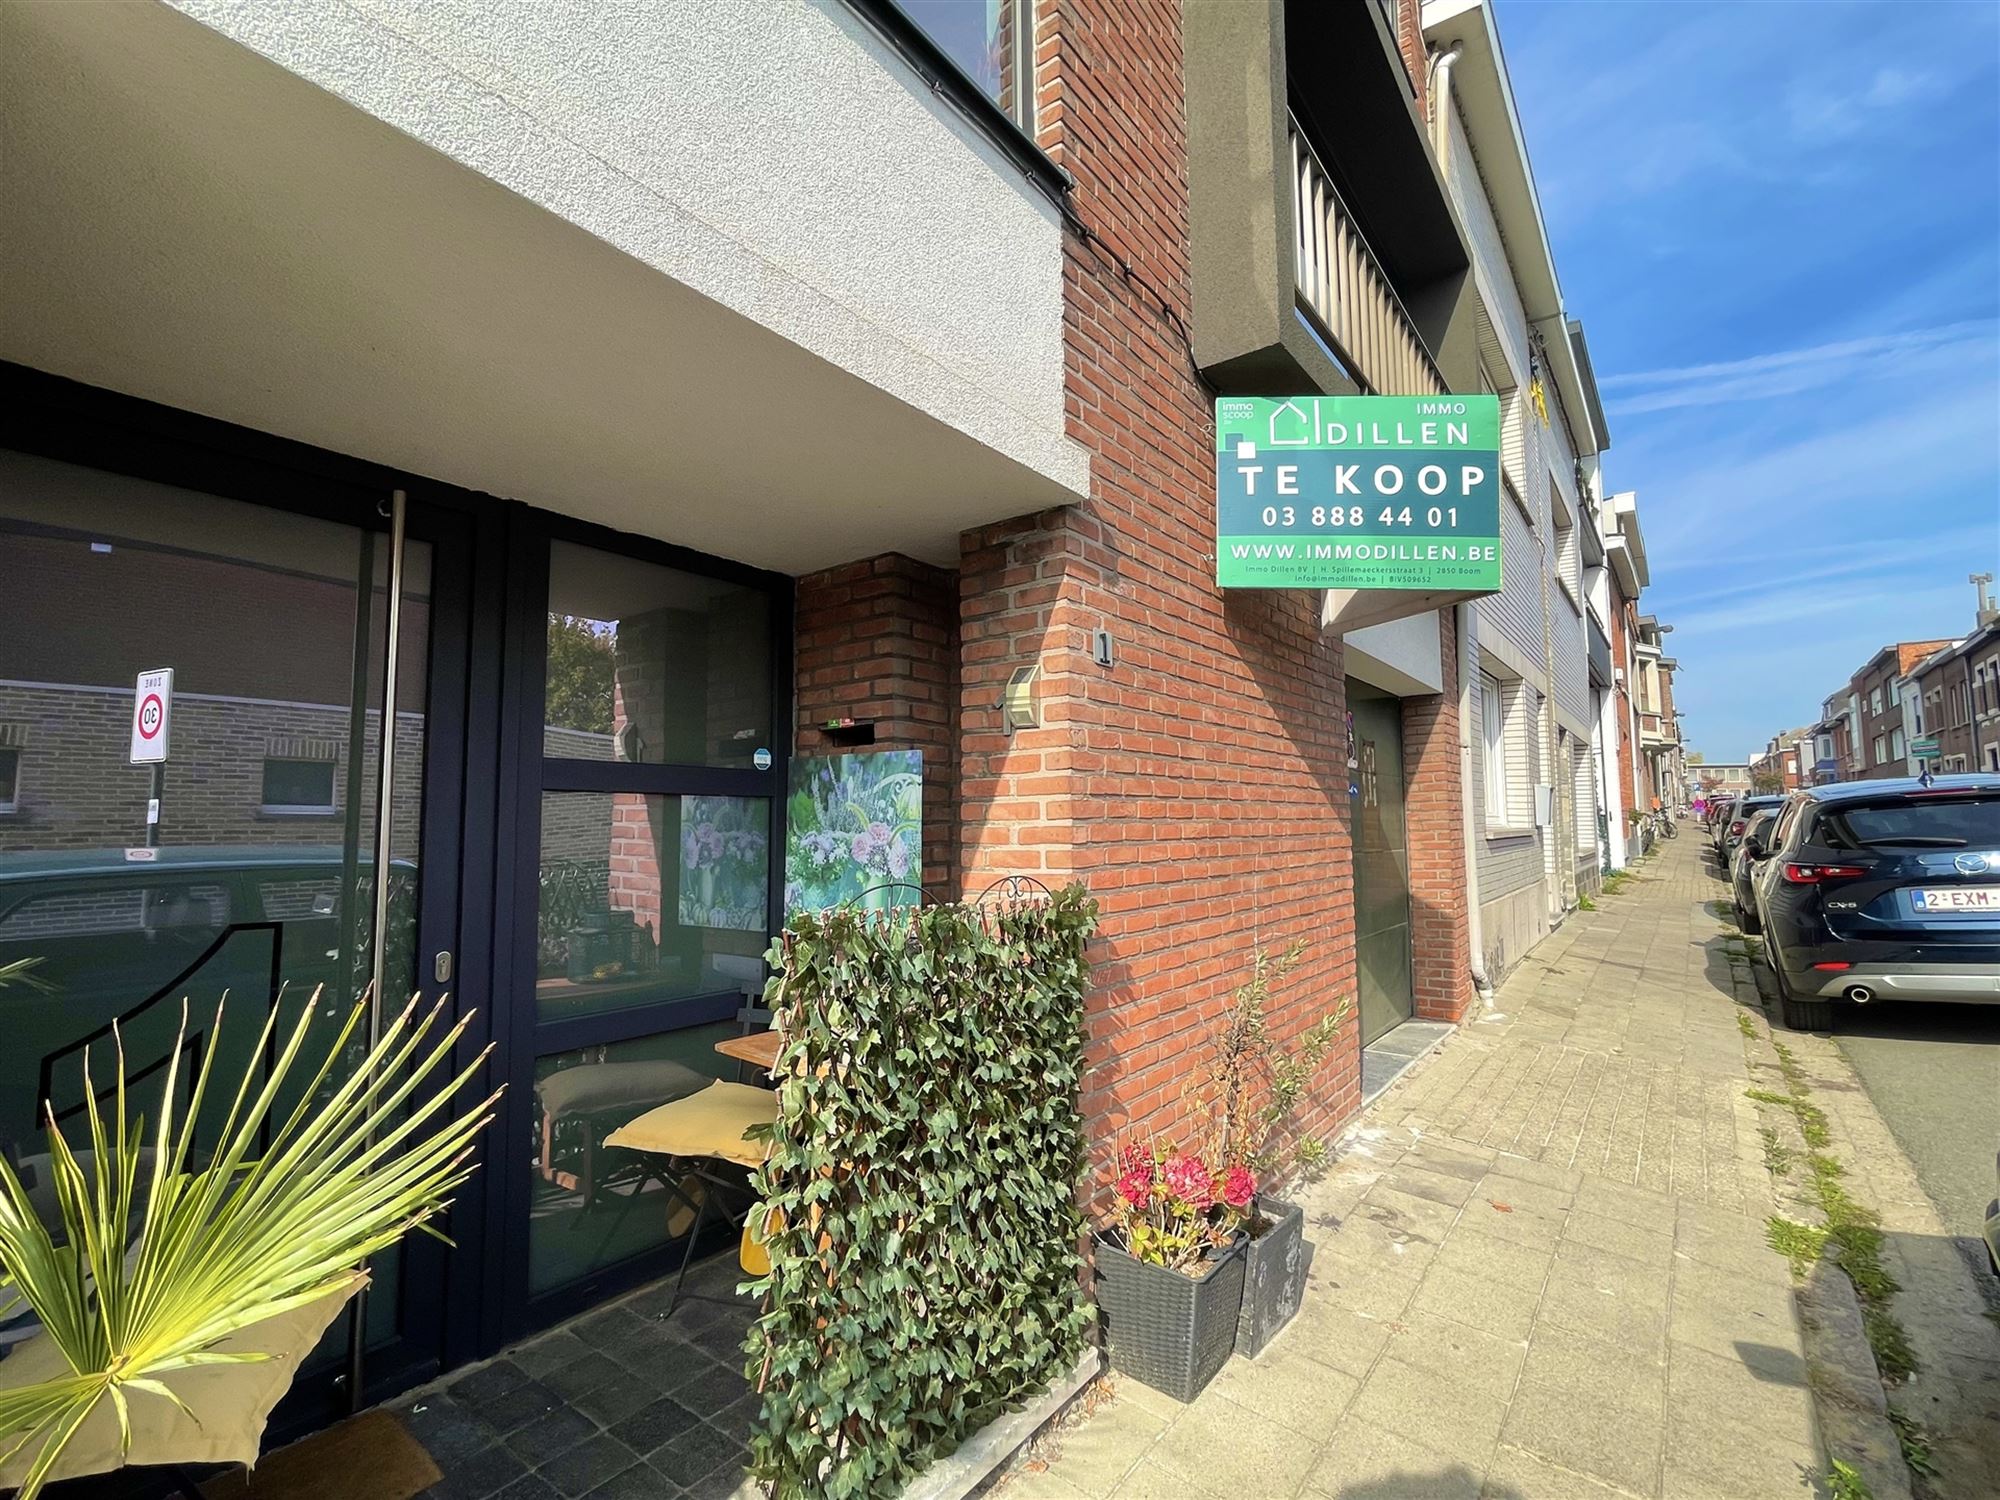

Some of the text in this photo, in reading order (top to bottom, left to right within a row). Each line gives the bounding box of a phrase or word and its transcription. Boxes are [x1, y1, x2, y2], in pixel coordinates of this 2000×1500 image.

[1222, 401, 1253, 411] immo
[1223, 411, 1253, 420] scoop
[1417, 403, 1466, 415] IMMO
[1327, 422, 1469, 445] DILLEN
[1237, 464, 1485, 496] TE KOOP
[1262, 506, 1457, 527] 03 888 44 01
[1231, 544, 1496, 561] WWW.IMMODILLEN.BE
[1099, 633, 1110, 663] 1
